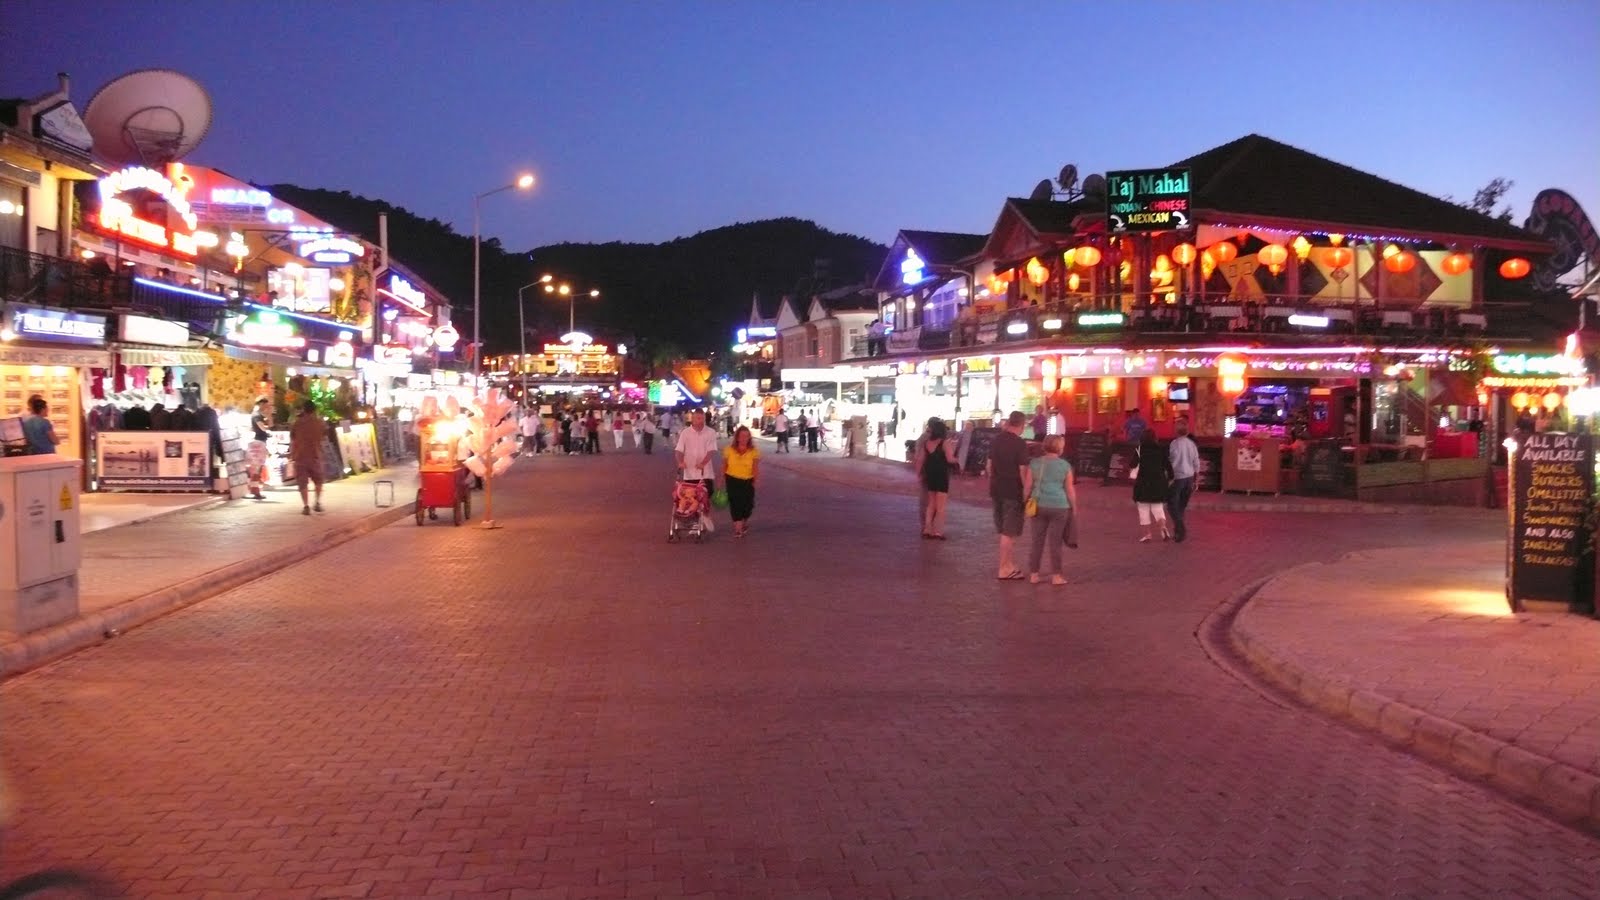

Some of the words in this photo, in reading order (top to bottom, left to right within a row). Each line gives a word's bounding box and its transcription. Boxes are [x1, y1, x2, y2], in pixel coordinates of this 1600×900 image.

[1109, 176, 1135, 202] Taj
[1137, 171, 1190, 195] Mahal
[1110, 202, 1142, 213] INDIAN
[1150, 199, 1187, 211] CHINESE
[1128, 211, 1170, 224] MEXICAN
[1523, 435, 1550, 448] ALL
[1554, 435, 1579, 448] DAY
[1521, 447, 1585, 461] AVAILABLE
[1525, 527, 1546, 537] AND
[1549, 528, 1575, 539] ALSO
